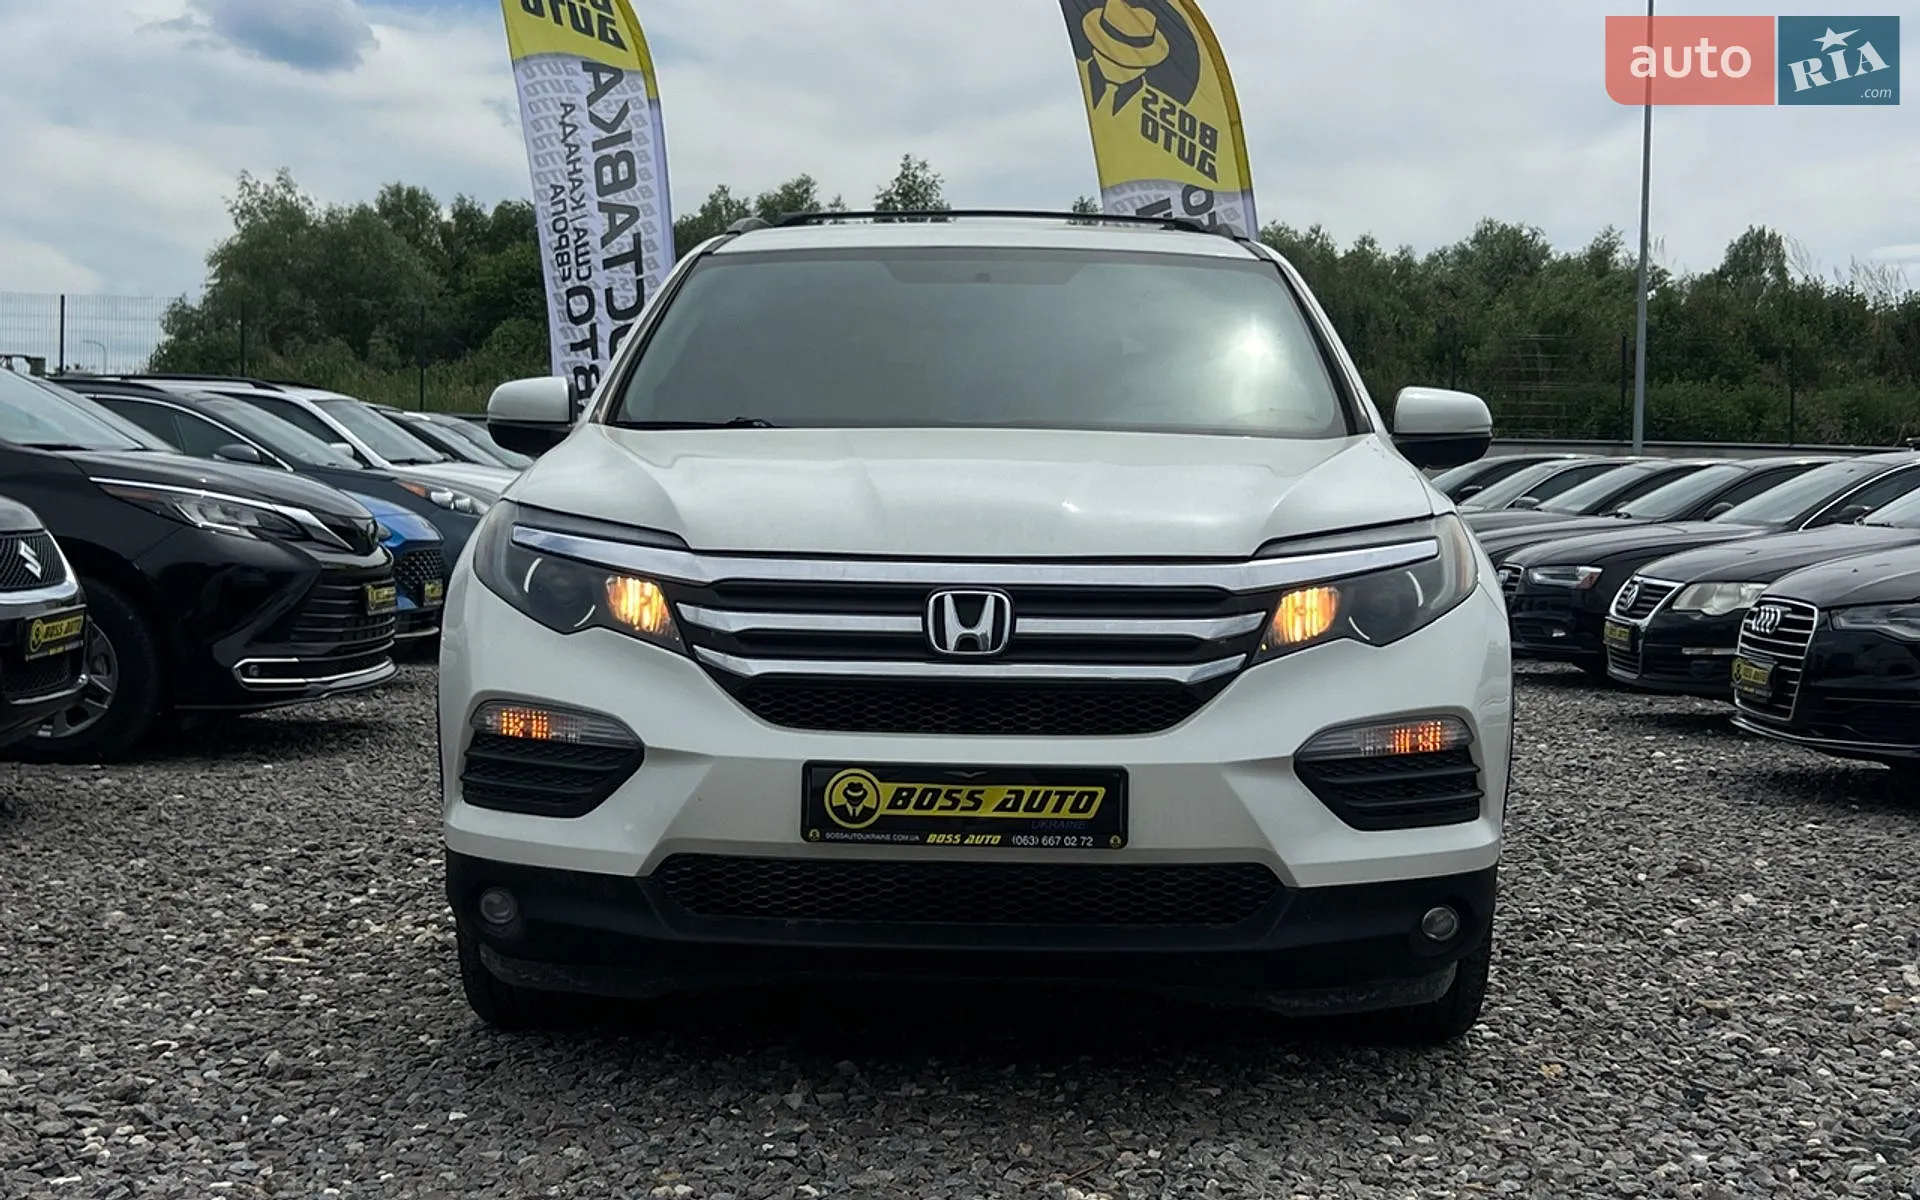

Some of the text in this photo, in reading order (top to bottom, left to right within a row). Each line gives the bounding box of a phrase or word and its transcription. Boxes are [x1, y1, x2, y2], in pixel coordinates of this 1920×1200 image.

[885, 787, 1098, 814] BOSS AUTO
[1030, 819, 1087, 830] UKRAINE
[926, 833, 1001, 845] BOSS AUTO
[1012, 835, 1093, 847] (063) 667 02 72
